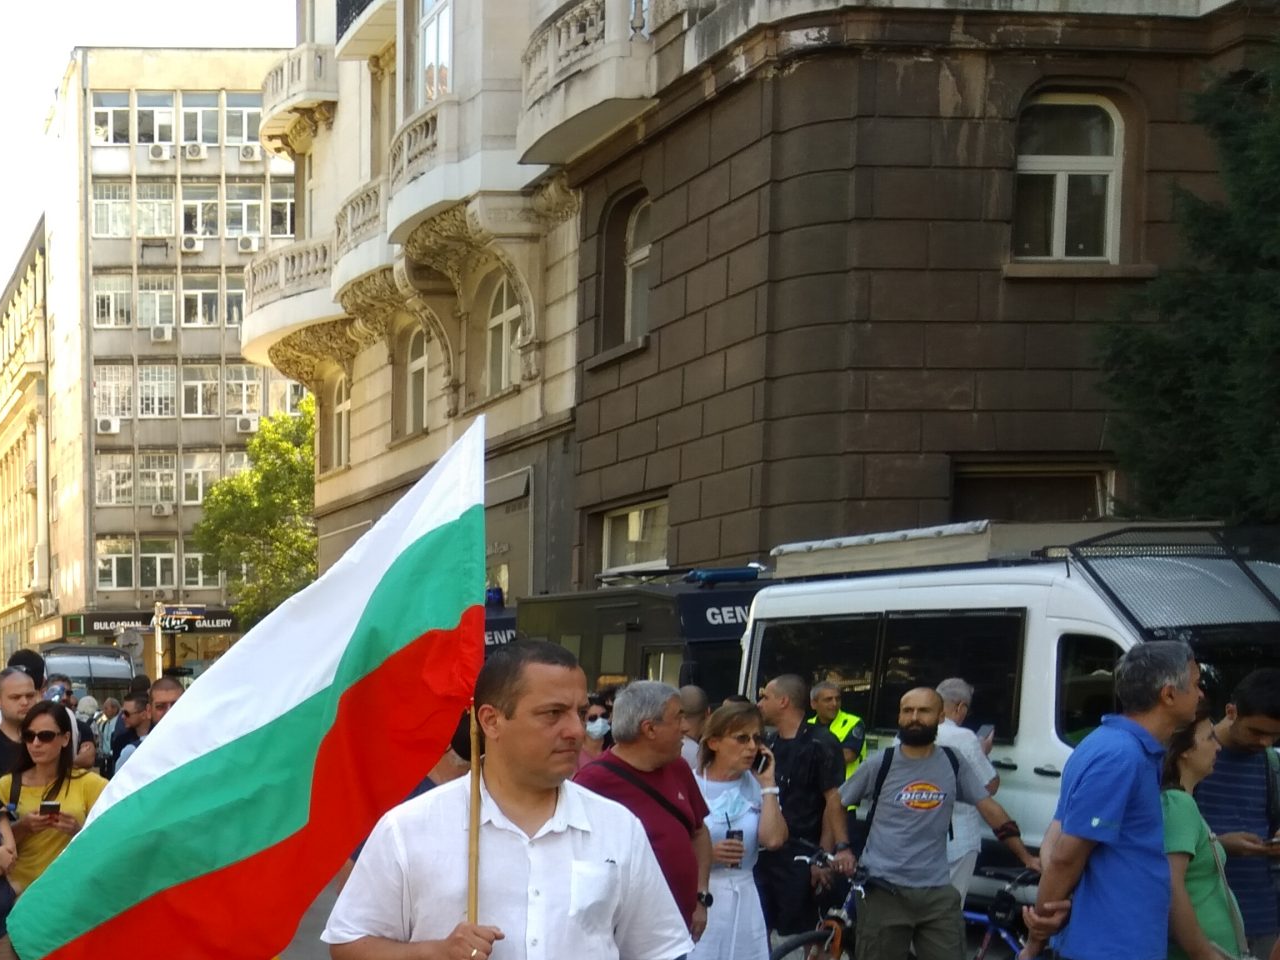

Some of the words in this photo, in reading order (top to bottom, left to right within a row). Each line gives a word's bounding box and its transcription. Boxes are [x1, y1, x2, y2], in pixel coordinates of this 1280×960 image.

[706, 605, 750, 625] GEN
[195, 619, 232, 628] GALLERY
[900, 791, 945, 801] Dickies
